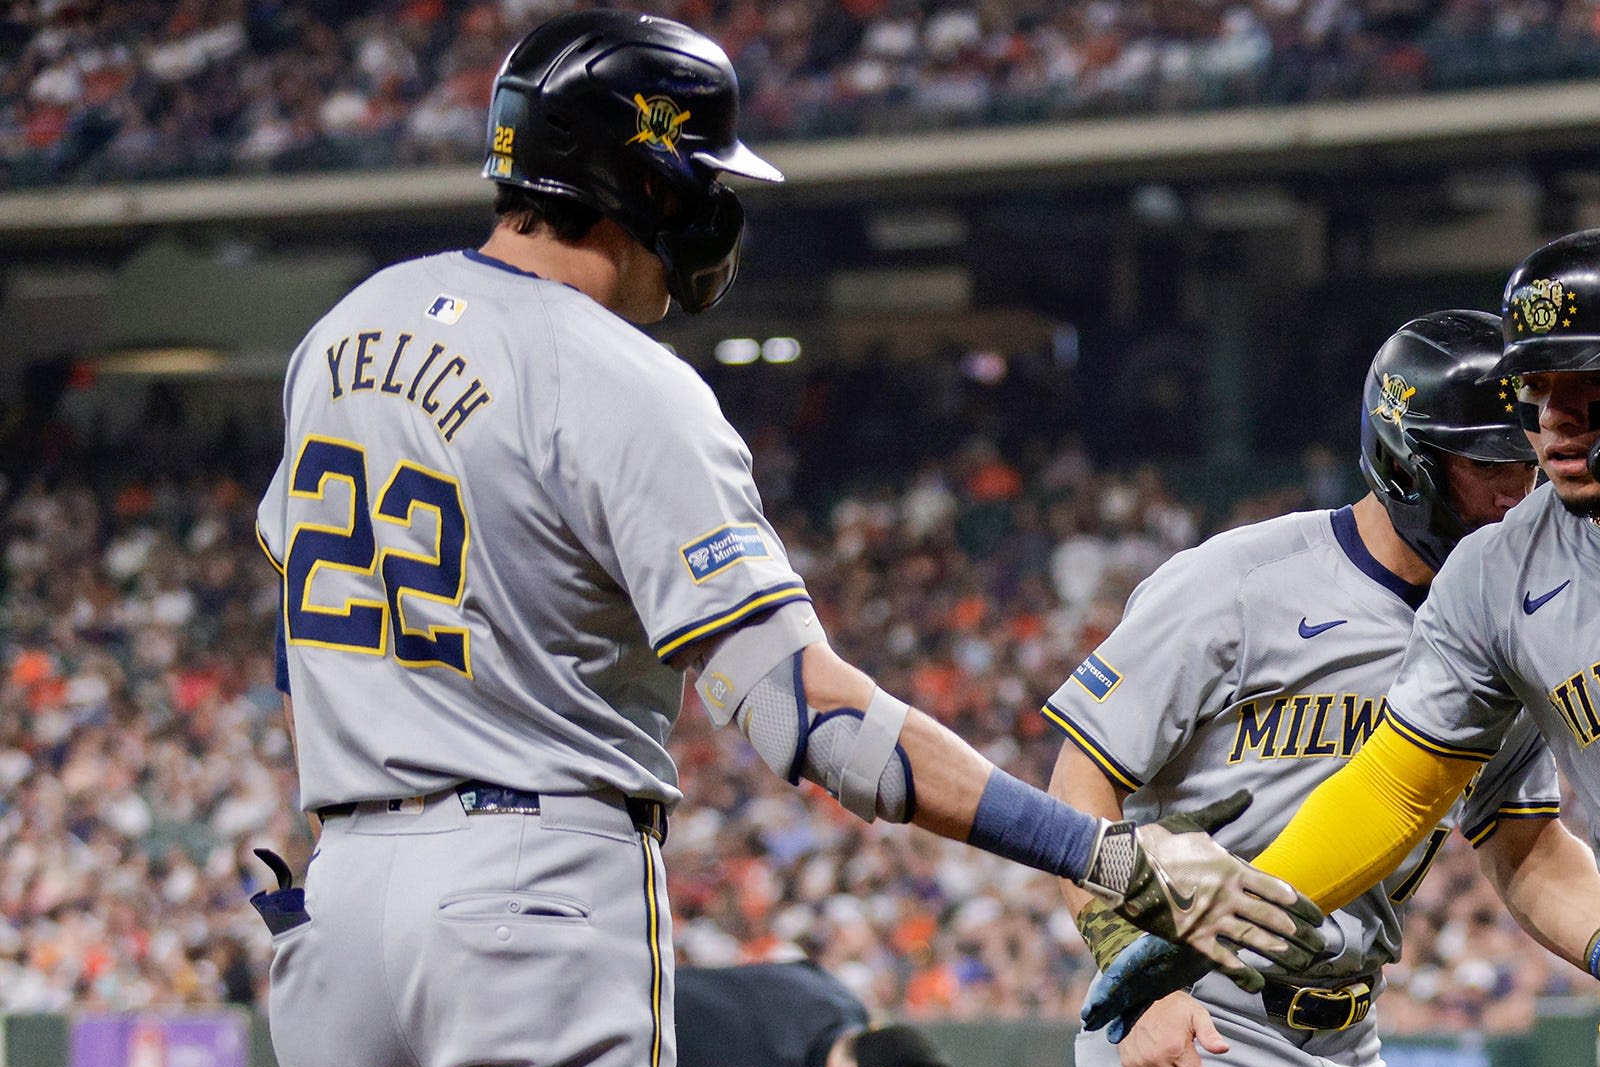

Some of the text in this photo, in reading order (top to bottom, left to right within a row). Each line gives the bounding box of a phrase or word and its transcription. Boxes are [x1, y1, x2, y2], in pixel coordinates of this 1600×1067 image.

[493, 126, 516, 154] 22
[325, 330, 494, 444] YELICH
[283, 433, 475, 681] 22
